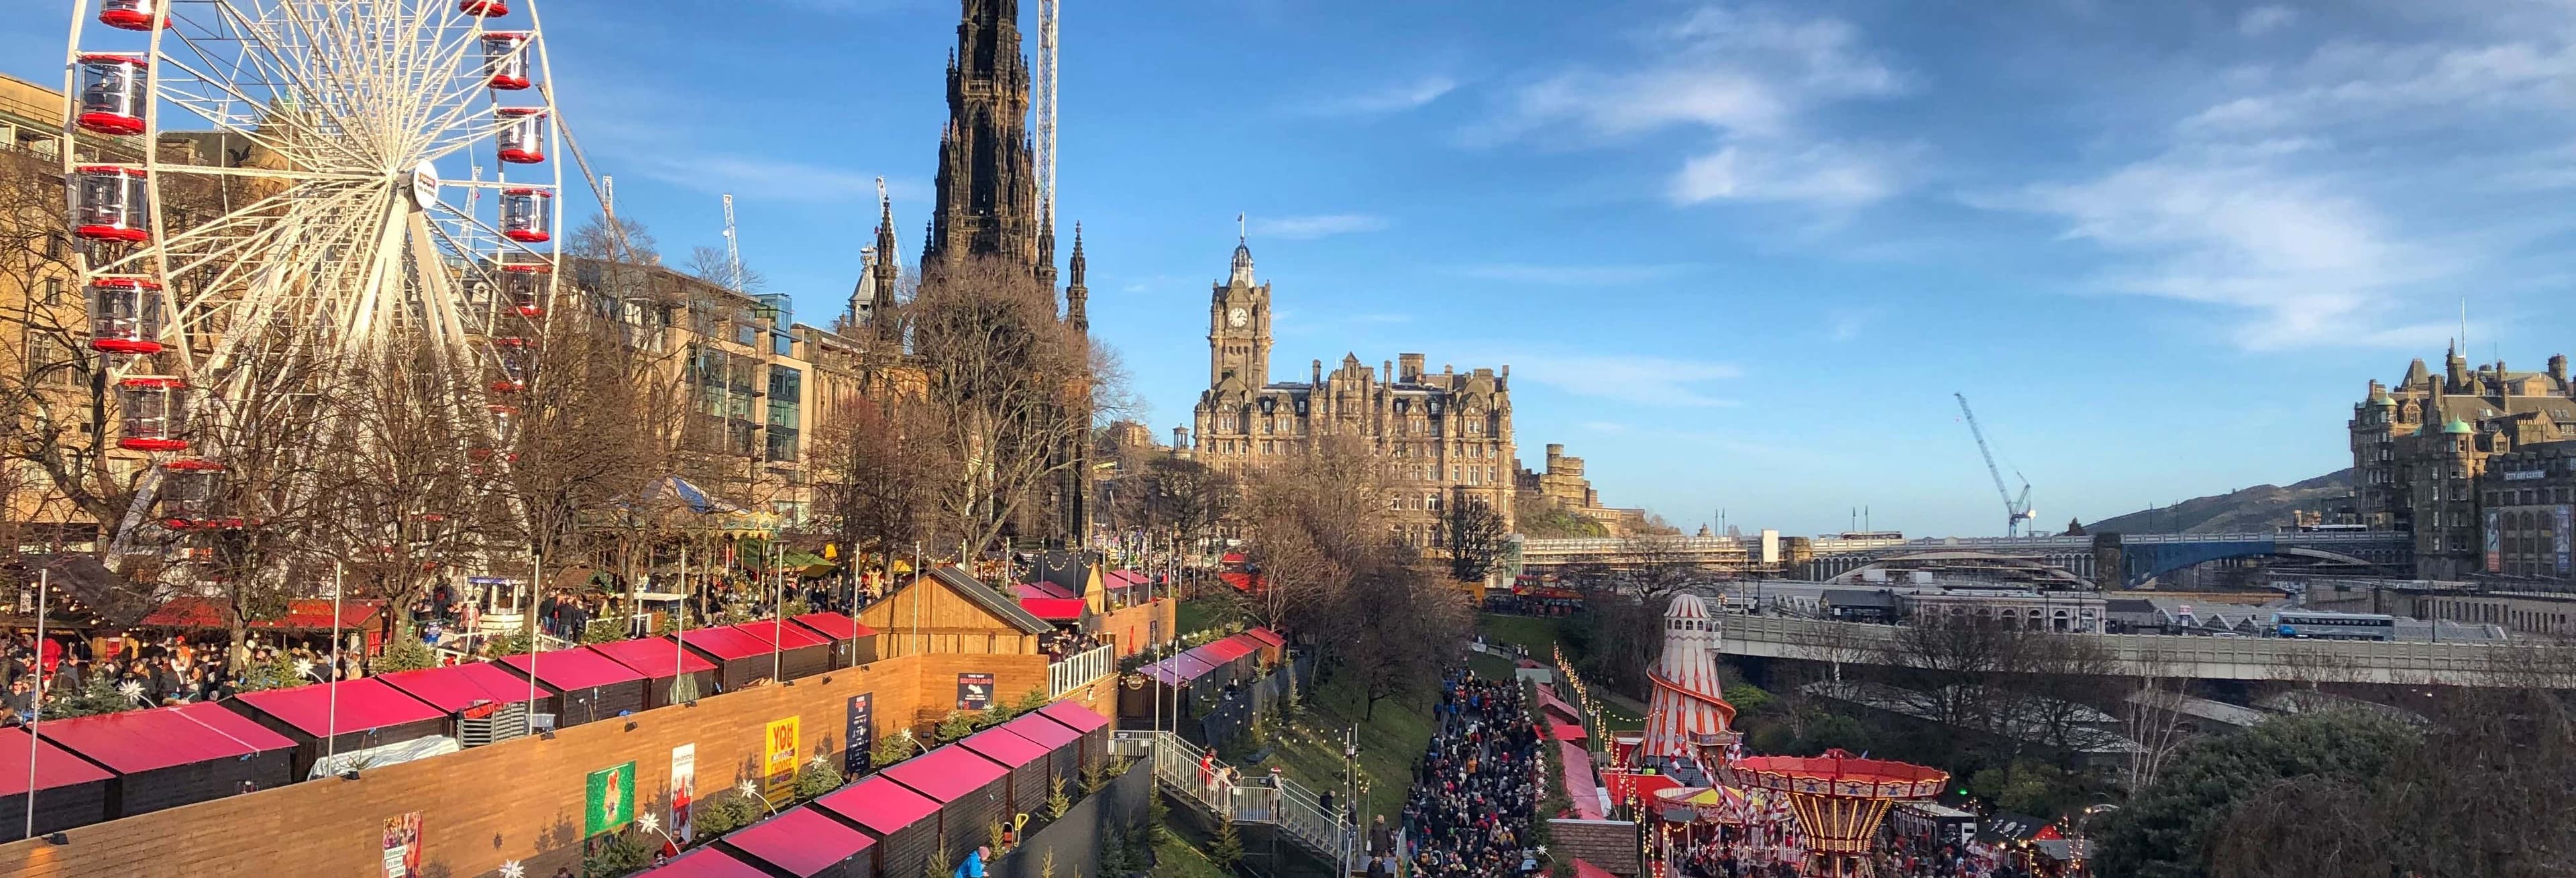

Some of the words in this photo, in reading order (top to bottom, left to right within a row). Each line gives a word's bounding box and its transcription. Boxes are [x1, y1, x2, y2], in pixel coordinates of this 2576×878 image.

[2506, 472, 2516, 480] CITY
[2526, 470, 2544, 479] CENTRE
[773, 722, 793, 753] YOU
